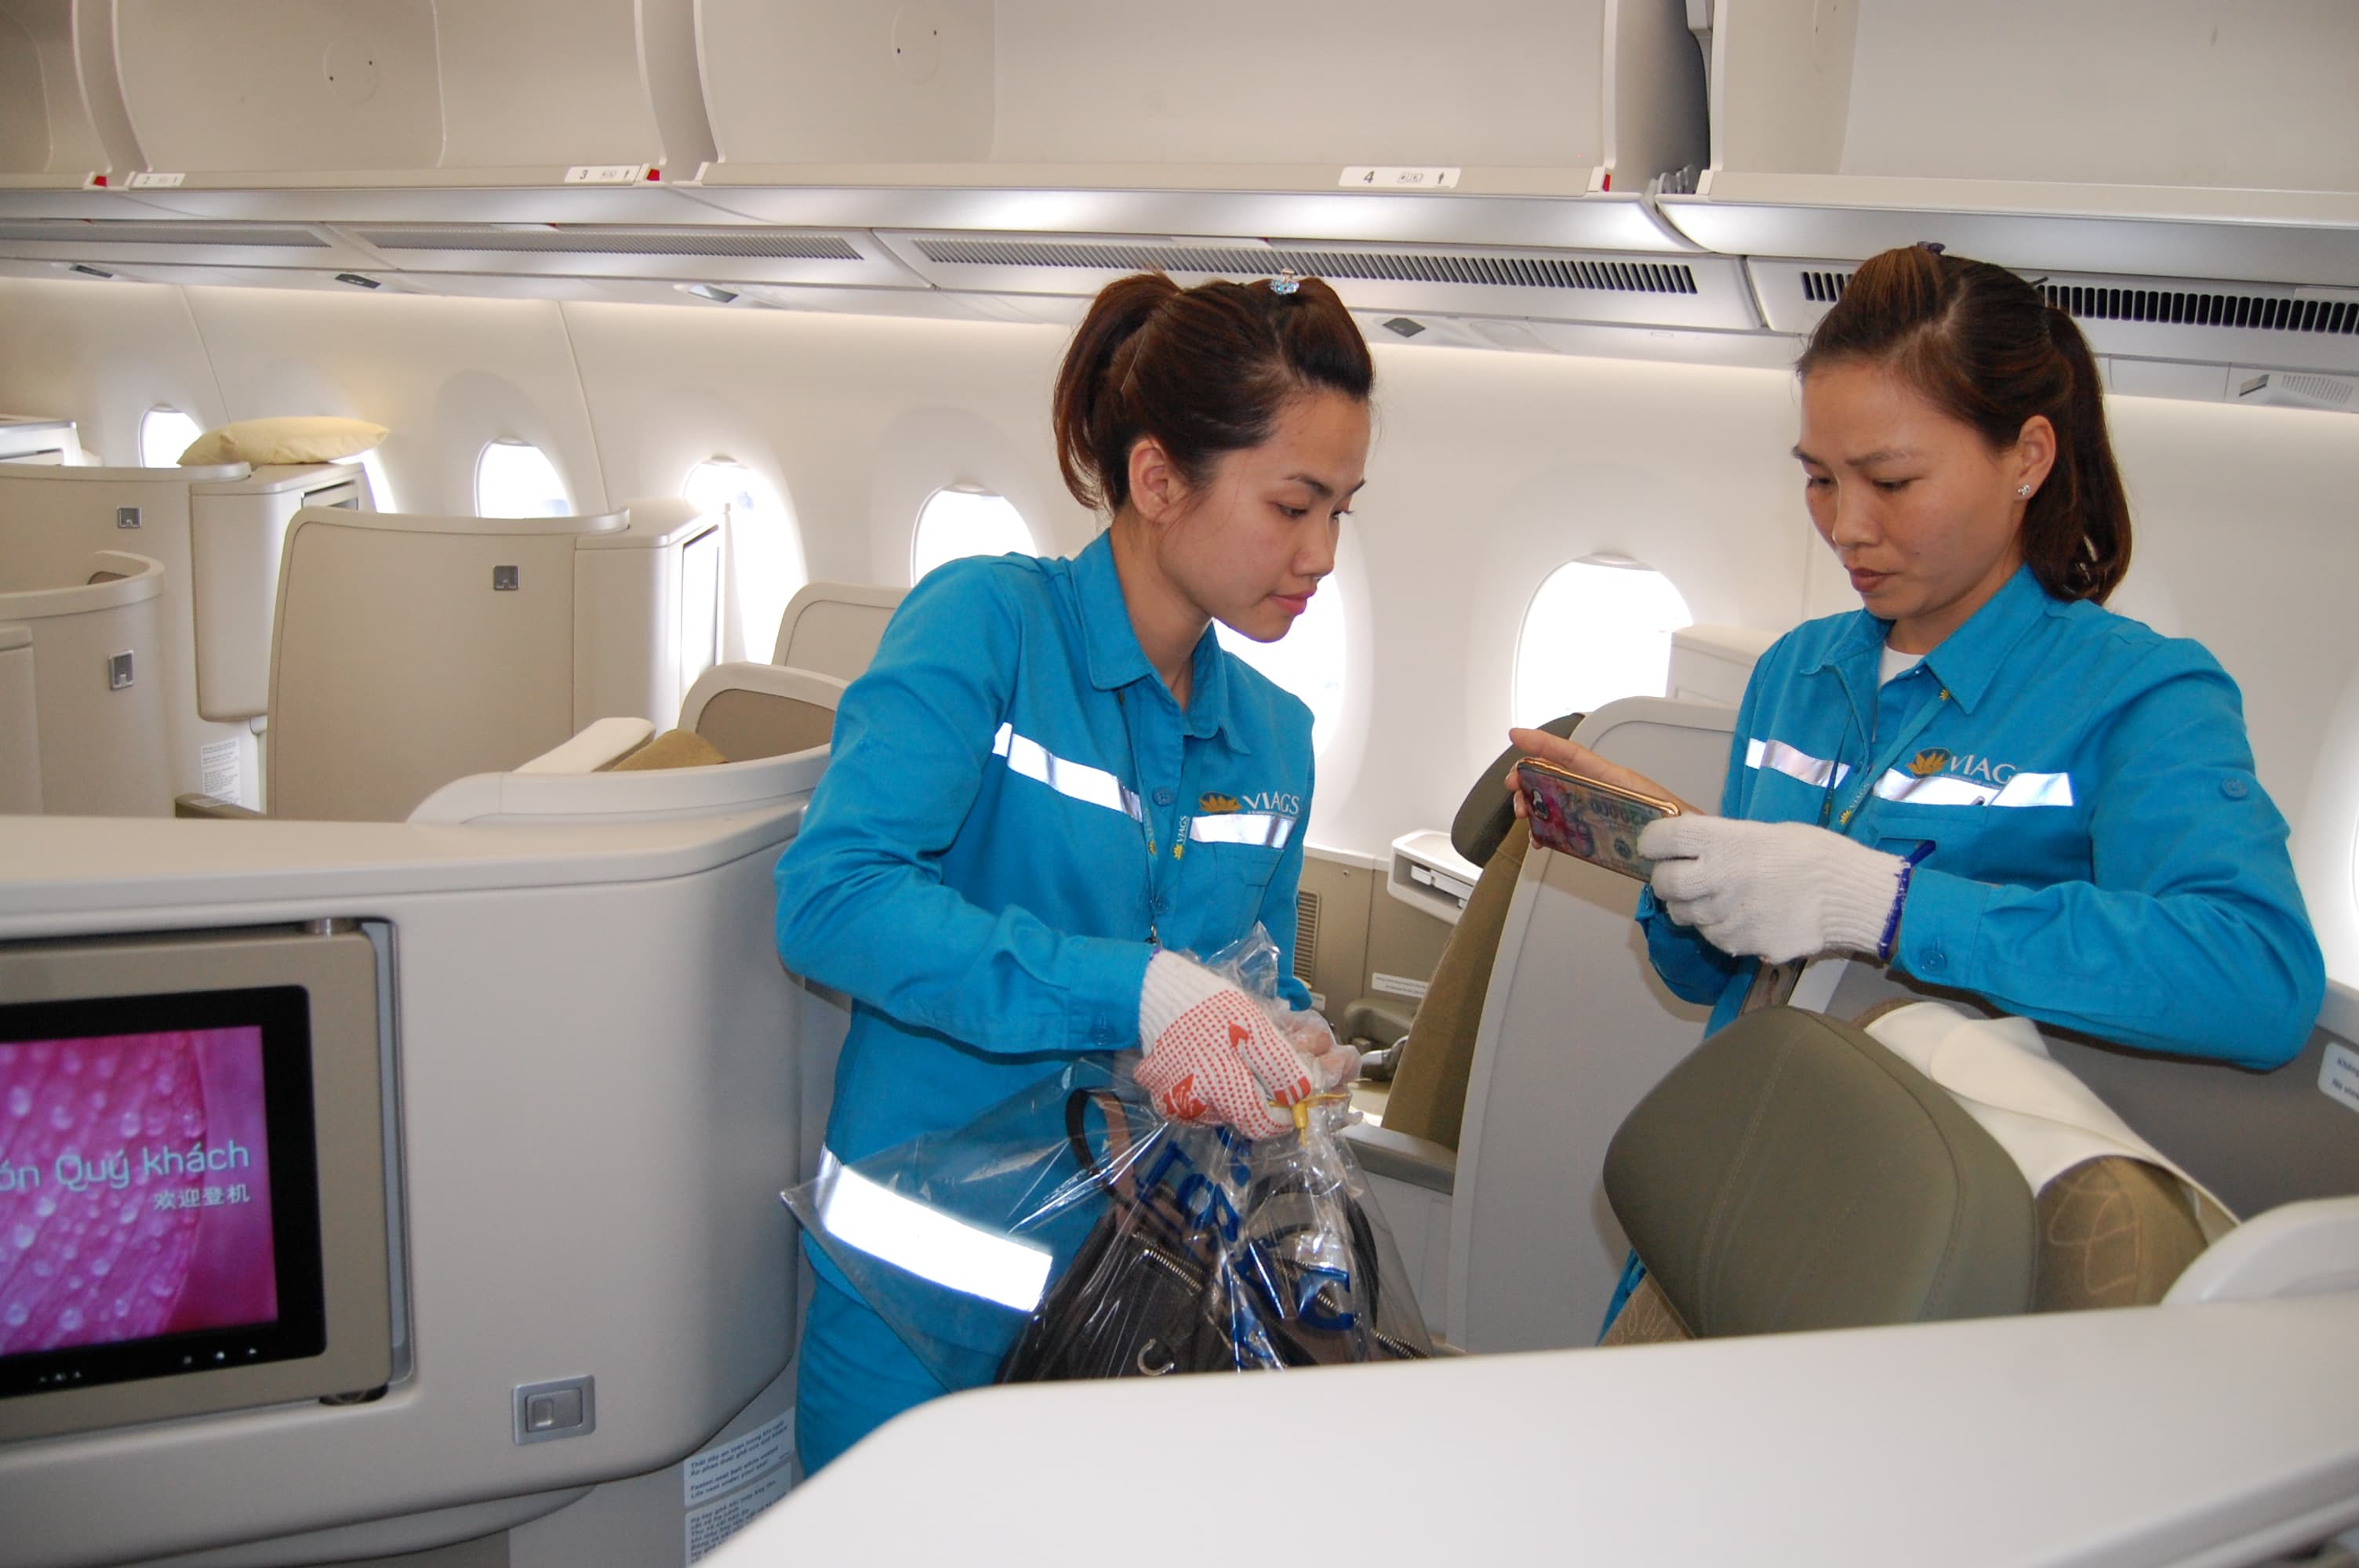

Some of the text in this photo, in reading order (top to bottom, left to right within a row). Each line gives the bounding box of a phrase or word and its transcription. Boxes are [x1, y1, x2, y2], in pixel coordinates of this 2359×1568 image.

[579, 169, 588, 180] 3
[1363, 171, 1375, 183] 4
[1950, 754, 2017, 785] VIAG
[1242, 791, 1299, 815] VIAGS
[1176, 815, 1188, 844] VIAGS
[55, 1148, 130, 1192] Quý
[142, 1139, 250, 1177] khách
[154, 1183, 250, 1211] 欢迎登机
